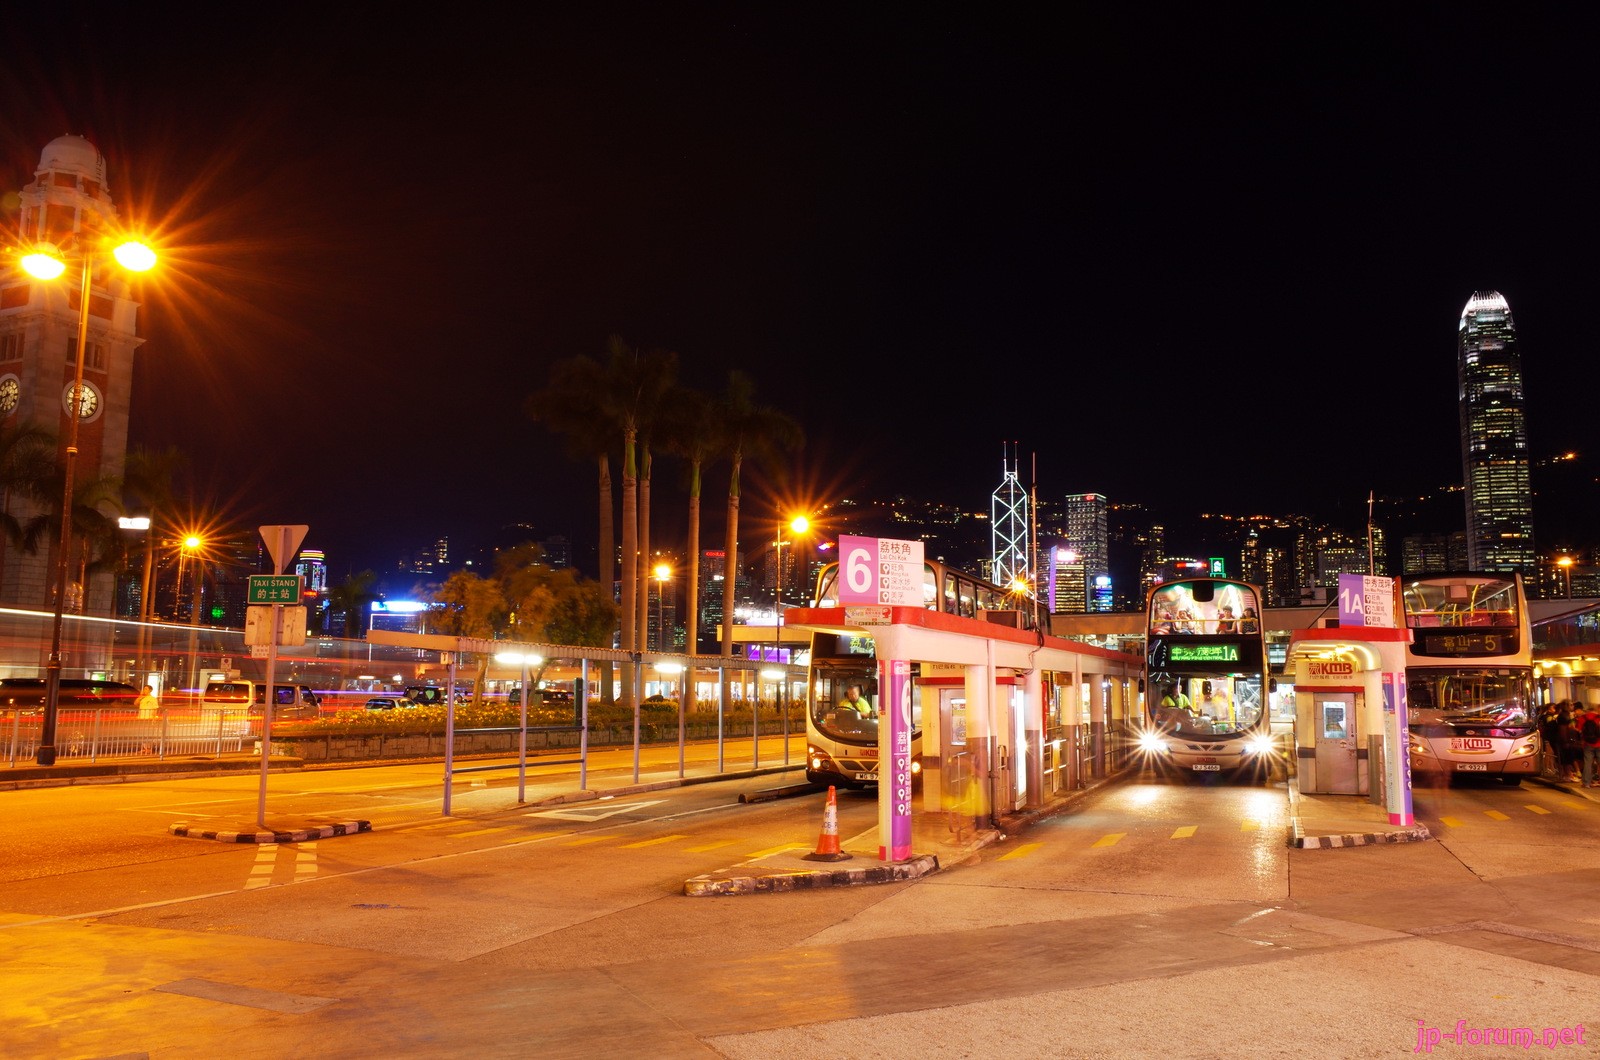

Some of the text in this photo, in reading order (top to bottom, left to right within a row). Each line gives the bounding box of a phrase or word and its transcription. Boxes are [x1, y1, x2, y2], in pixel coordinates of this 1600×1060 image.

[880, 541, 911, 555] 荔枝角
[846, 548, 873, 593] 6
[1364, 578, 1391, 588] 中秀茂坪
[257, 589, 290, 599] 的士站
[1340, 588, 1364, 614] 1A
[1486, 635, 1496, 651] 5
[1223, 646, 1238, 660] 1A
[1464, 739, 1492, 749] KMB
